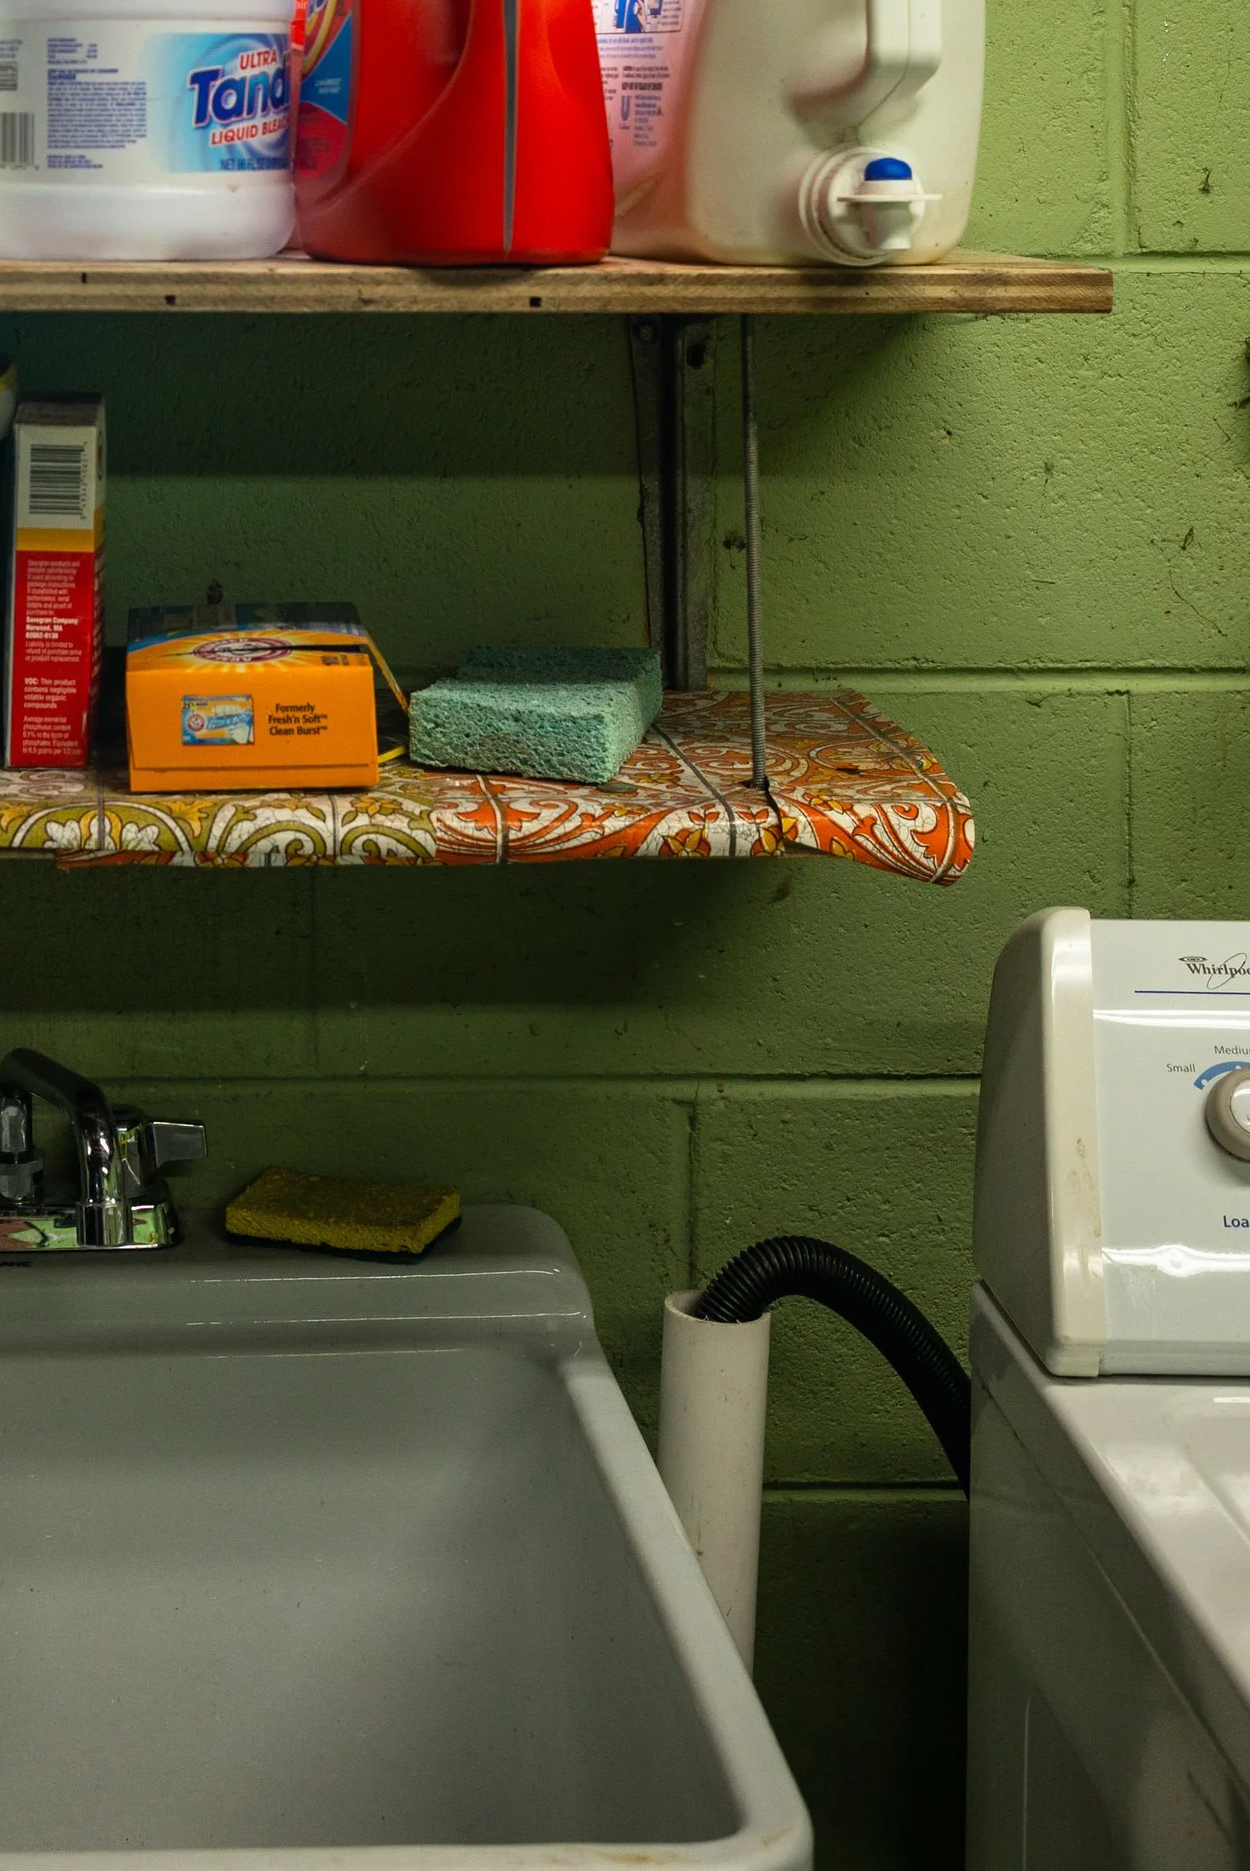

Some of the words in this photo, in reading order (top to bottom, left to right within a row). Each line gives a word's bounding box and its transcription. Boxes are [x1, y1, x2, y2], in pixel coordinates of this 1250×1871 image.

[239, 49, 278, 72] ULTRA
[211, 124, 258, 145] LIQUID
[276, 702, 315, 714] Formerly
[269, 725, 295, 735] Clean
[1167, 1063, 1196, 1073] Small
[1223, 1215, 1250, 1228] Loa
